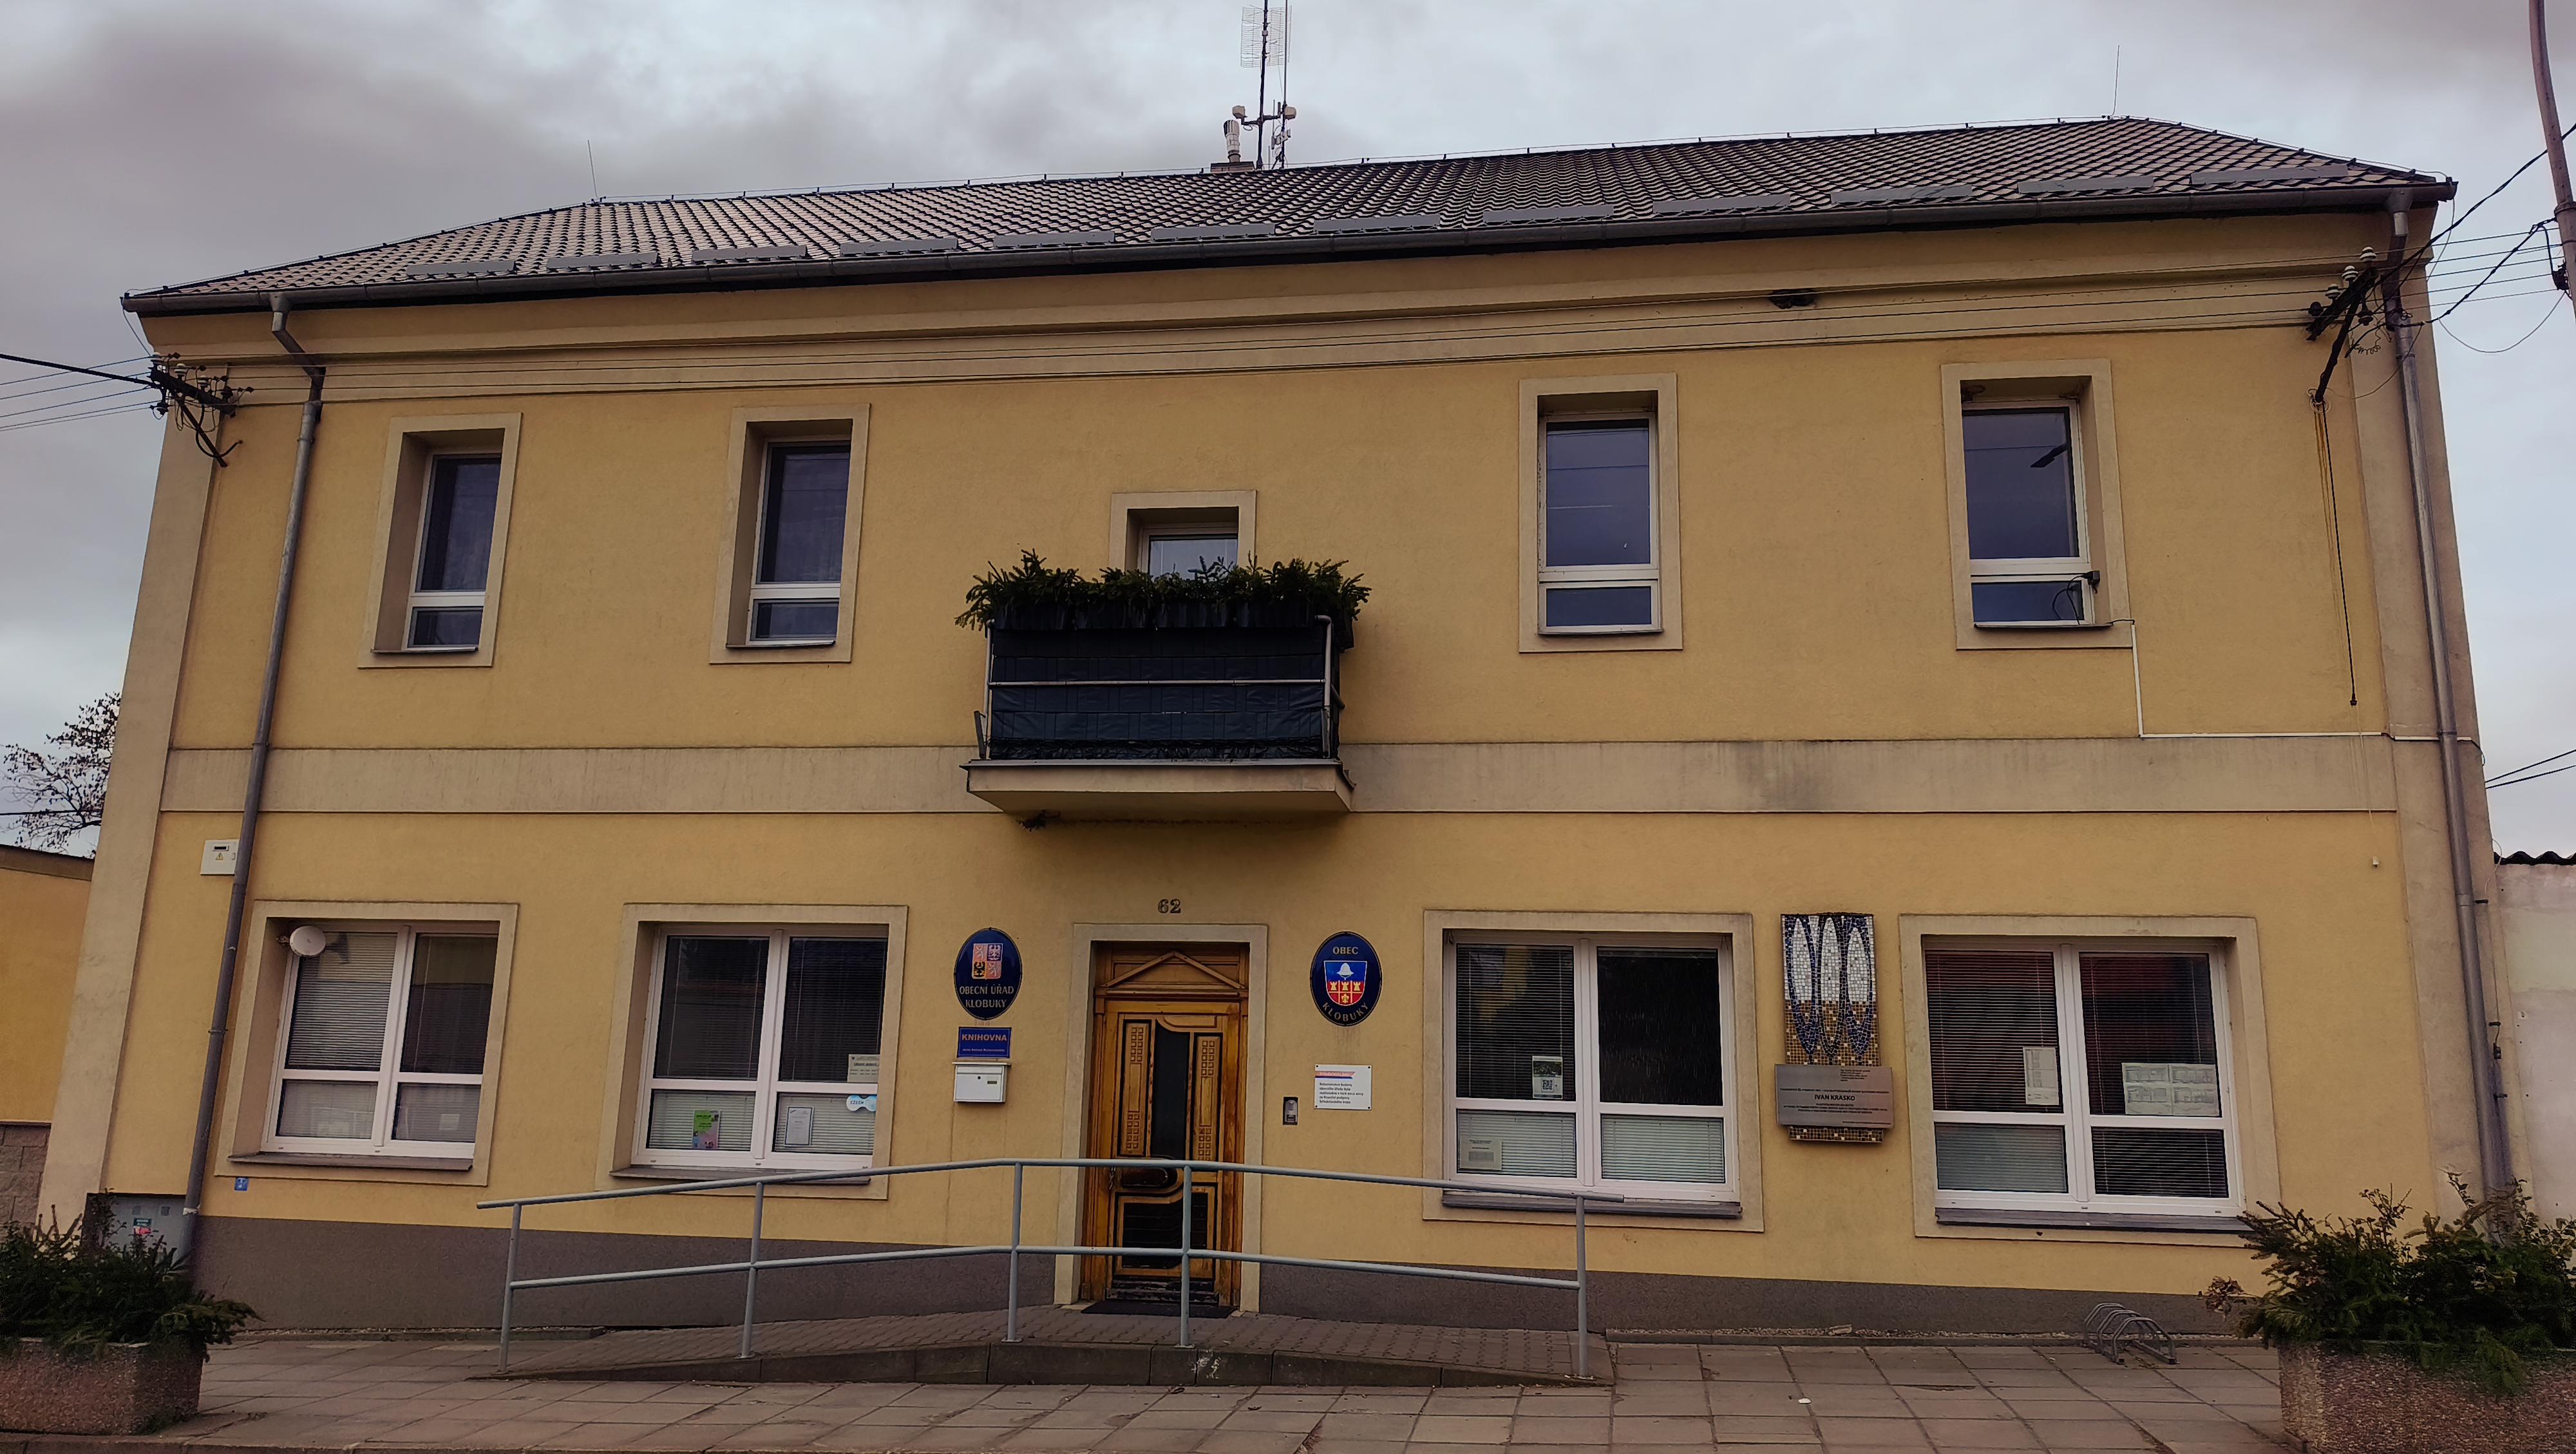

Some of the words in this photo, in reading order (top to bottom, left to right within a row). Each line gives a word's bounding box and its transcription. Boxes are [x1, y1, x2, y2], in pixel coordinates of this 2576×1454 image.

[1157, 898, 1181, 914] 62
[1332, 946, 1359, 955] OBEC
[959, 984, 988, 995] OBECNÍ
[990, 983, 1014, 995] ÚŘAD
[965, 999, 1007, 1008] KLOBUKY
[1322, 1001, 1368, 1023] KLOBUKY
